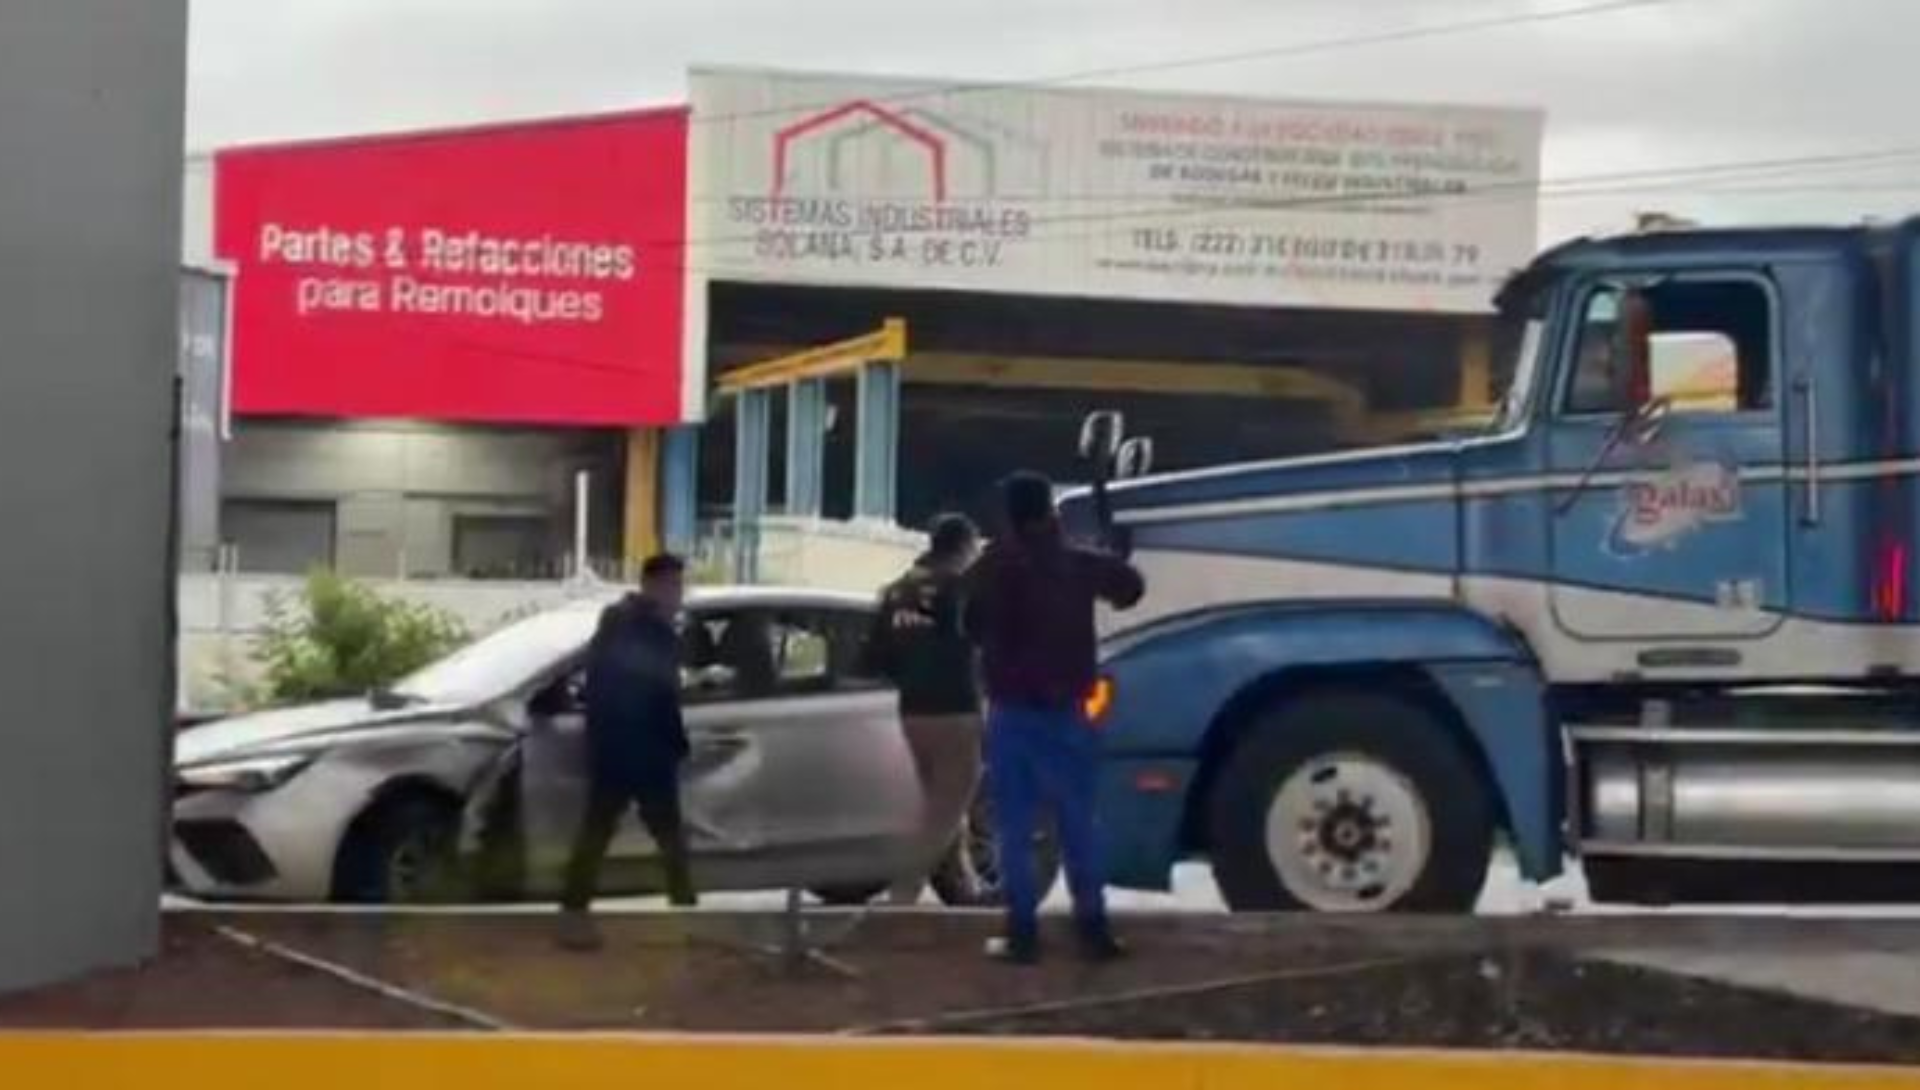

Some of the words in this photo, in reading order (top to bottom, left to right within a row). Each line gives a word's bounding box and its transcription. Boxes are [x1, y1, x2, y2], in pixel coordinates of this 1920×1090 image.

[728, 197, 851, 227] SISTEMAS
[859, 202, 1030, 237] INDUSTRIALES
[260, 223, 374, 267] Partes
[385, 227, 406, 269] &
[421, 228, 635, 281] Refacciones
[922, 238, 952, 266] DE
[297, 276, 381, 315] para
[391, 277, 604, 324] Remolques
